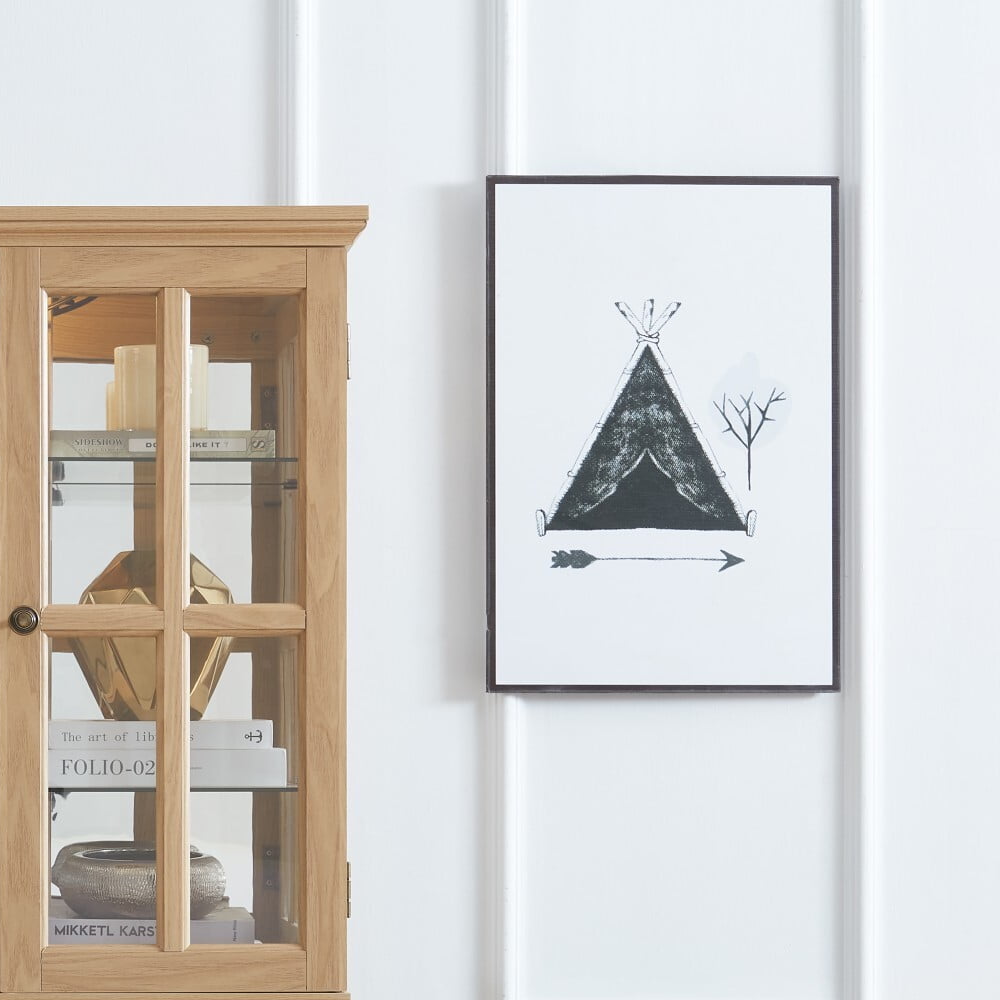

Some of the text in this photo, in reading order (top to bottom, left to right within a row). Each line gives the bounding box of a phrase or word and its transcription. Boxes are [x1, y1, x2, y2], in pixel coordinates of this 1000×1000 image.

[74, 438, 123, 446] SIDESHOW
[61, 732, 82, 742] The
[88, 733, 107, 742] art
[114, 732, 129, 742] of
[62, 758, 156, 776] FOLIO-02
[54, 924, 115, 937] MIKKETL
